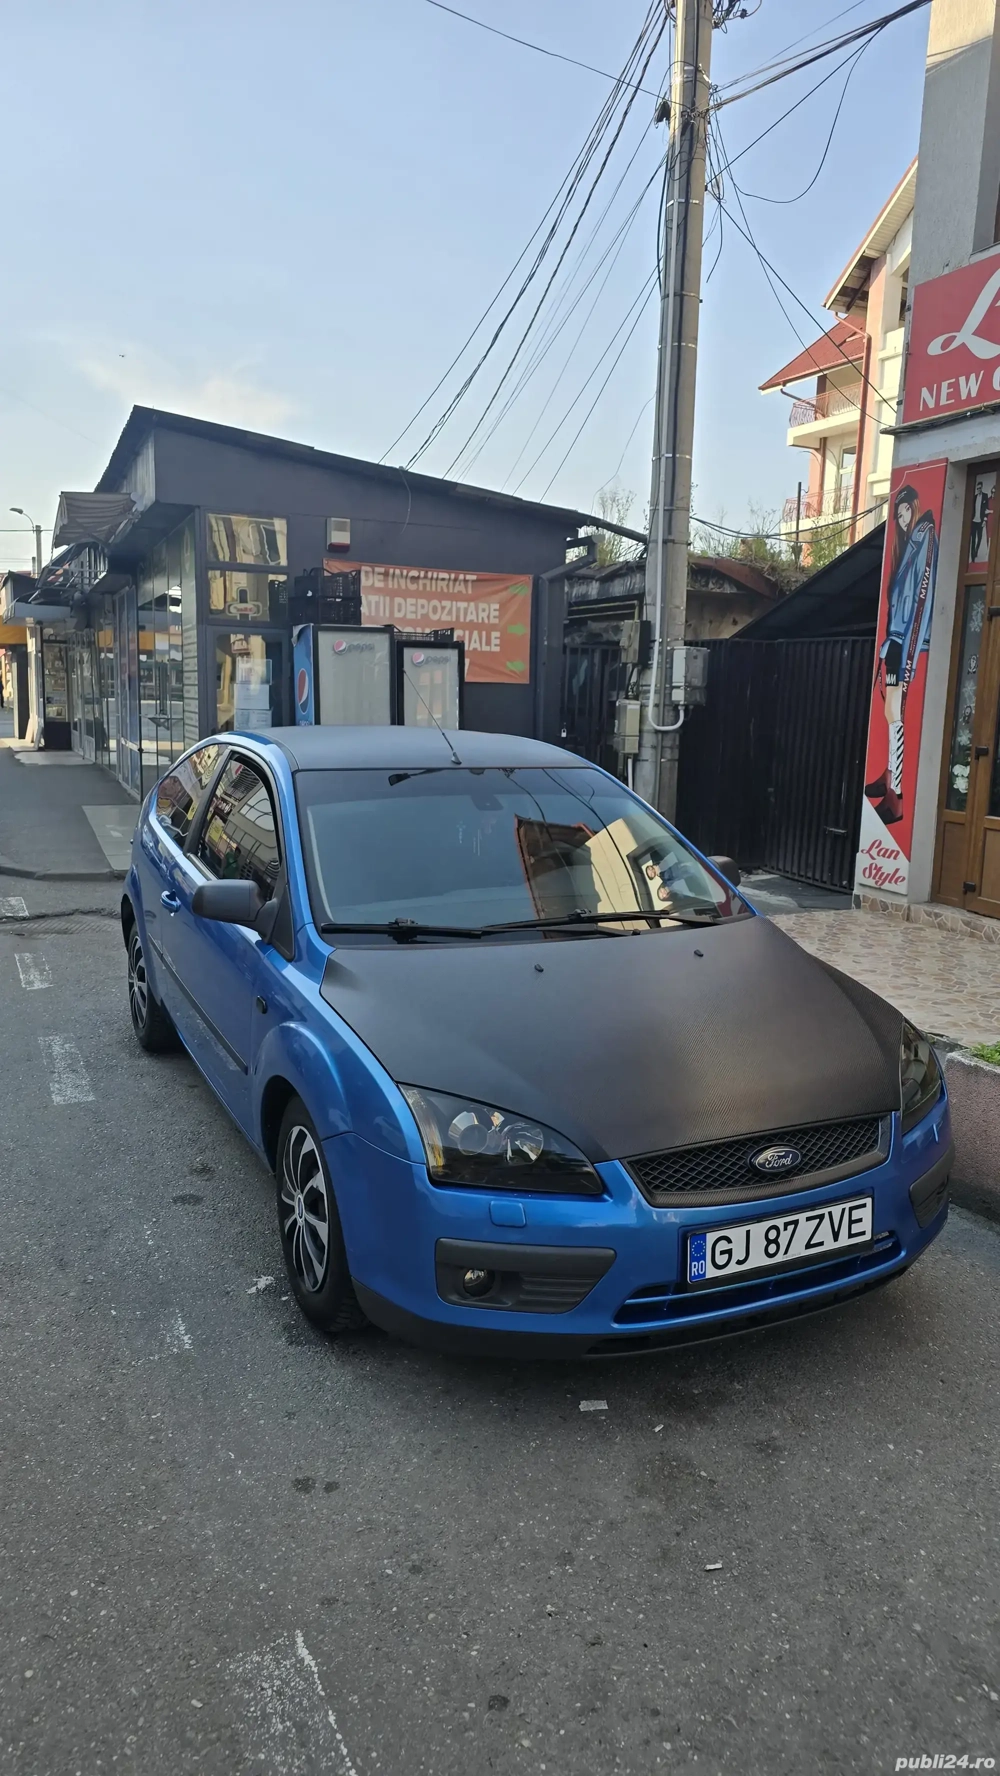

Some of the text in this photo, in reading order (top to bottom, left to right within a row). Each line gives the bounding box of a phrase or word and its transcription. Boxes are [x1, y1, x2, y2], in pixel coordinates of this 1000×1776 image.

[919, 370, 984, 411] NEW
[361, 565, 477, 594] DE INCHIRIAT
[360, 594, 500, 624] ATII DEPOZITARE
[860, 839, 900, 860] Lan
[862, 862, 906, 887] Style
[765, 1149, 793, 1168] Ford
[710, 1202, 867, 1270] GJ 87 ZVE
[691, 1260, 706, 1277] RO
